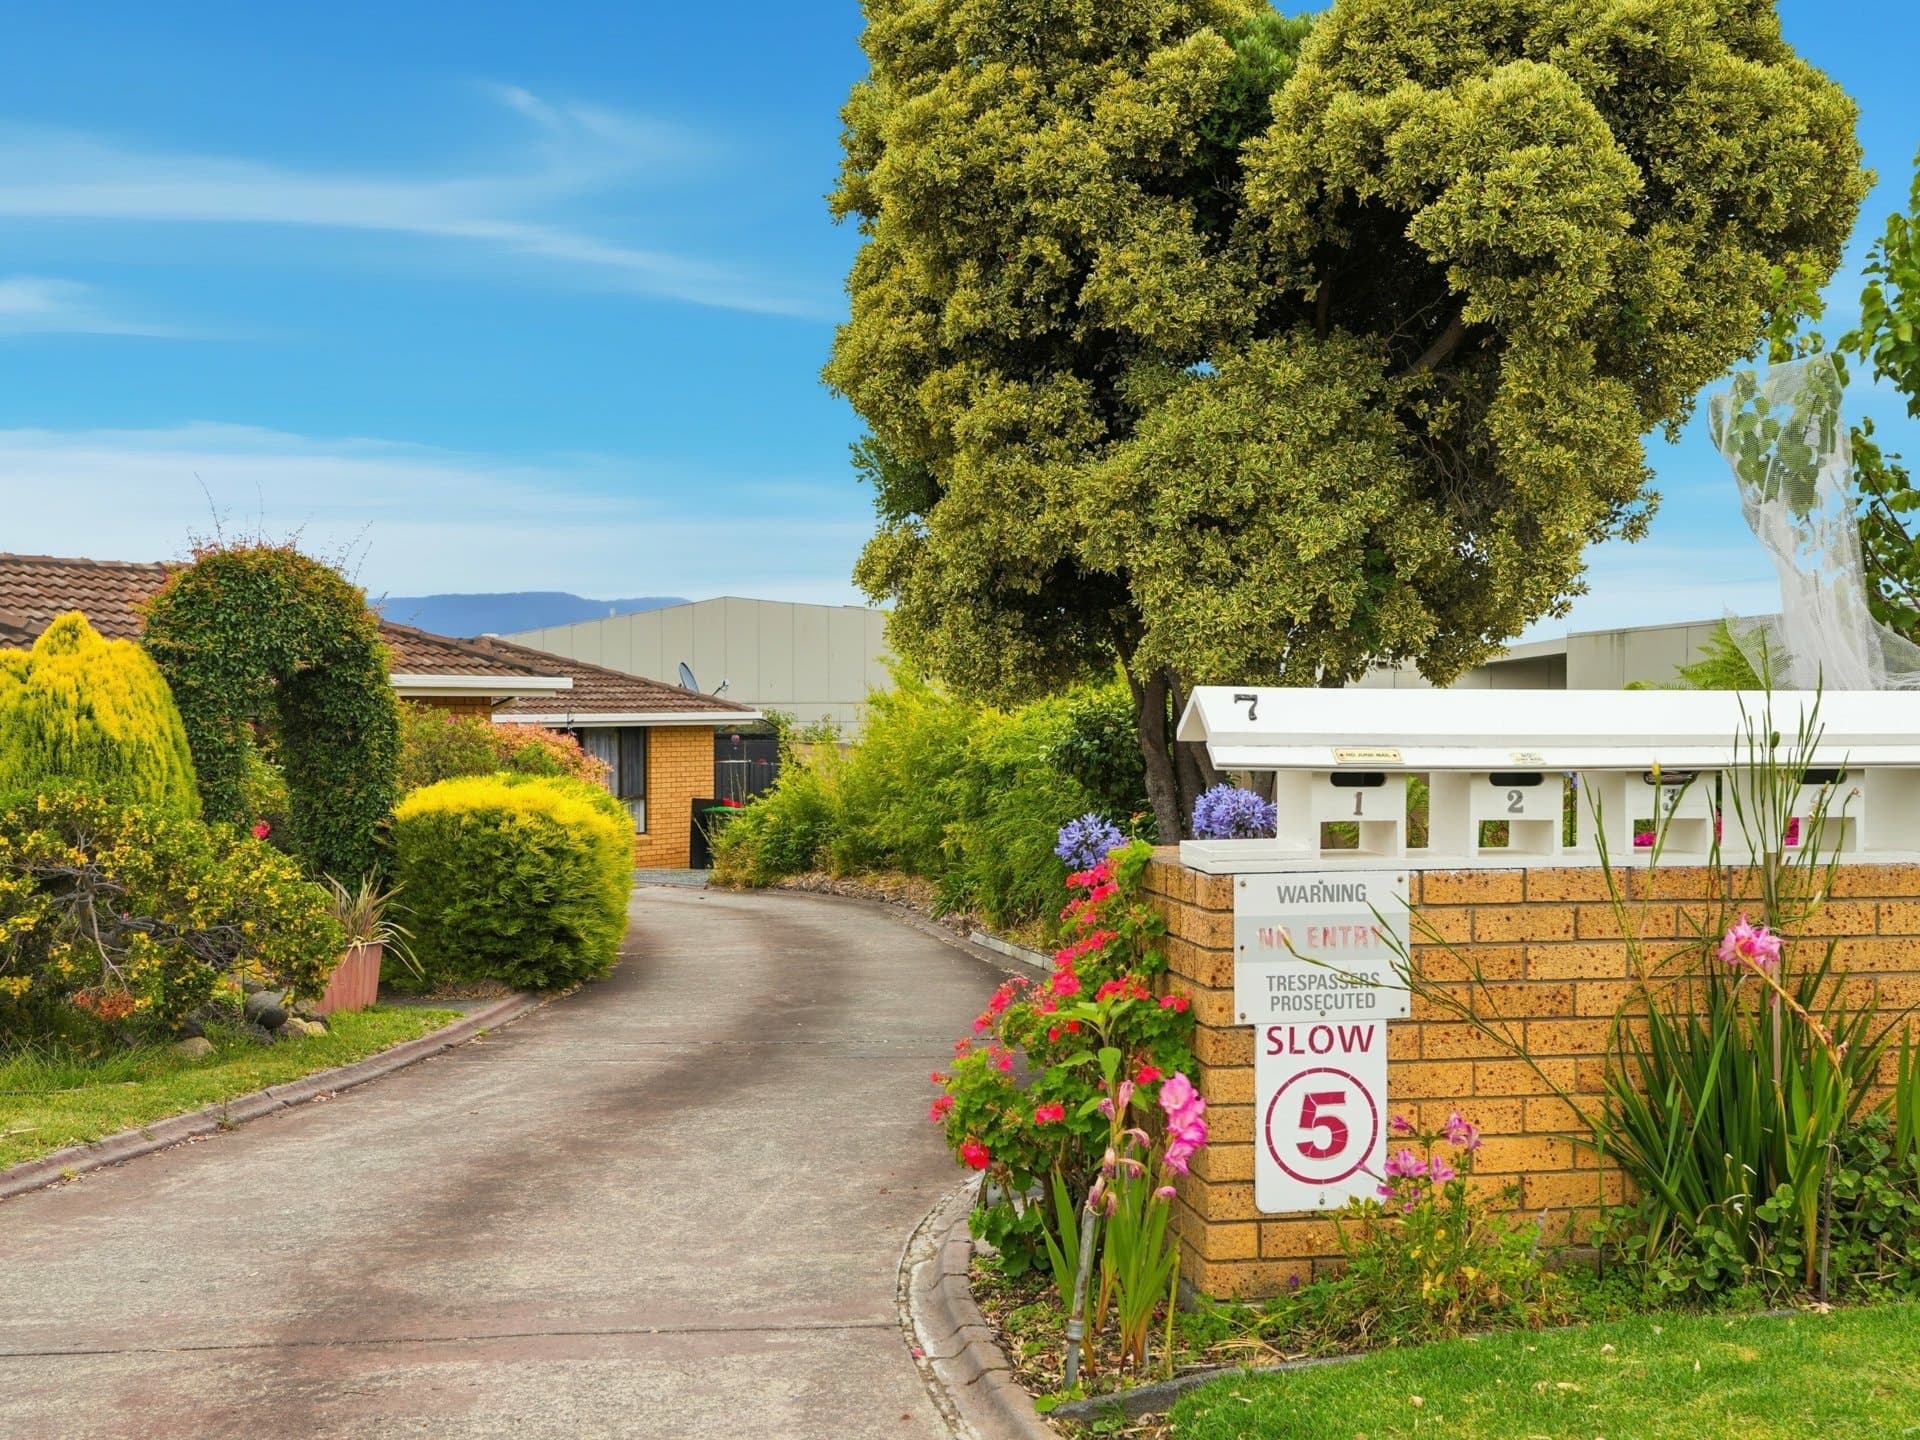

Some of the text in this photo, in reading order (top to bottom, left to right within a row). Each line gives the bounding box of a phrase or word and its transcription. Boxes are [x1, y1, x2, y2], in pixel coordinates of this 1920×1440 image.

[1234, 694, 1258, 721] 7
[1353, 791, 1363, 816] 1
[1507, 790, 1524, 813] 2
[1277, 883, 1367, 904] WARNING
[1306, 924, 1384, 949] ENTRY
[1270, 992, 1376, 1012] PROSECUTED
[1266, 1024, 1375, 1055] SLOW
[1296, 1091, 1348, 1159] 5
